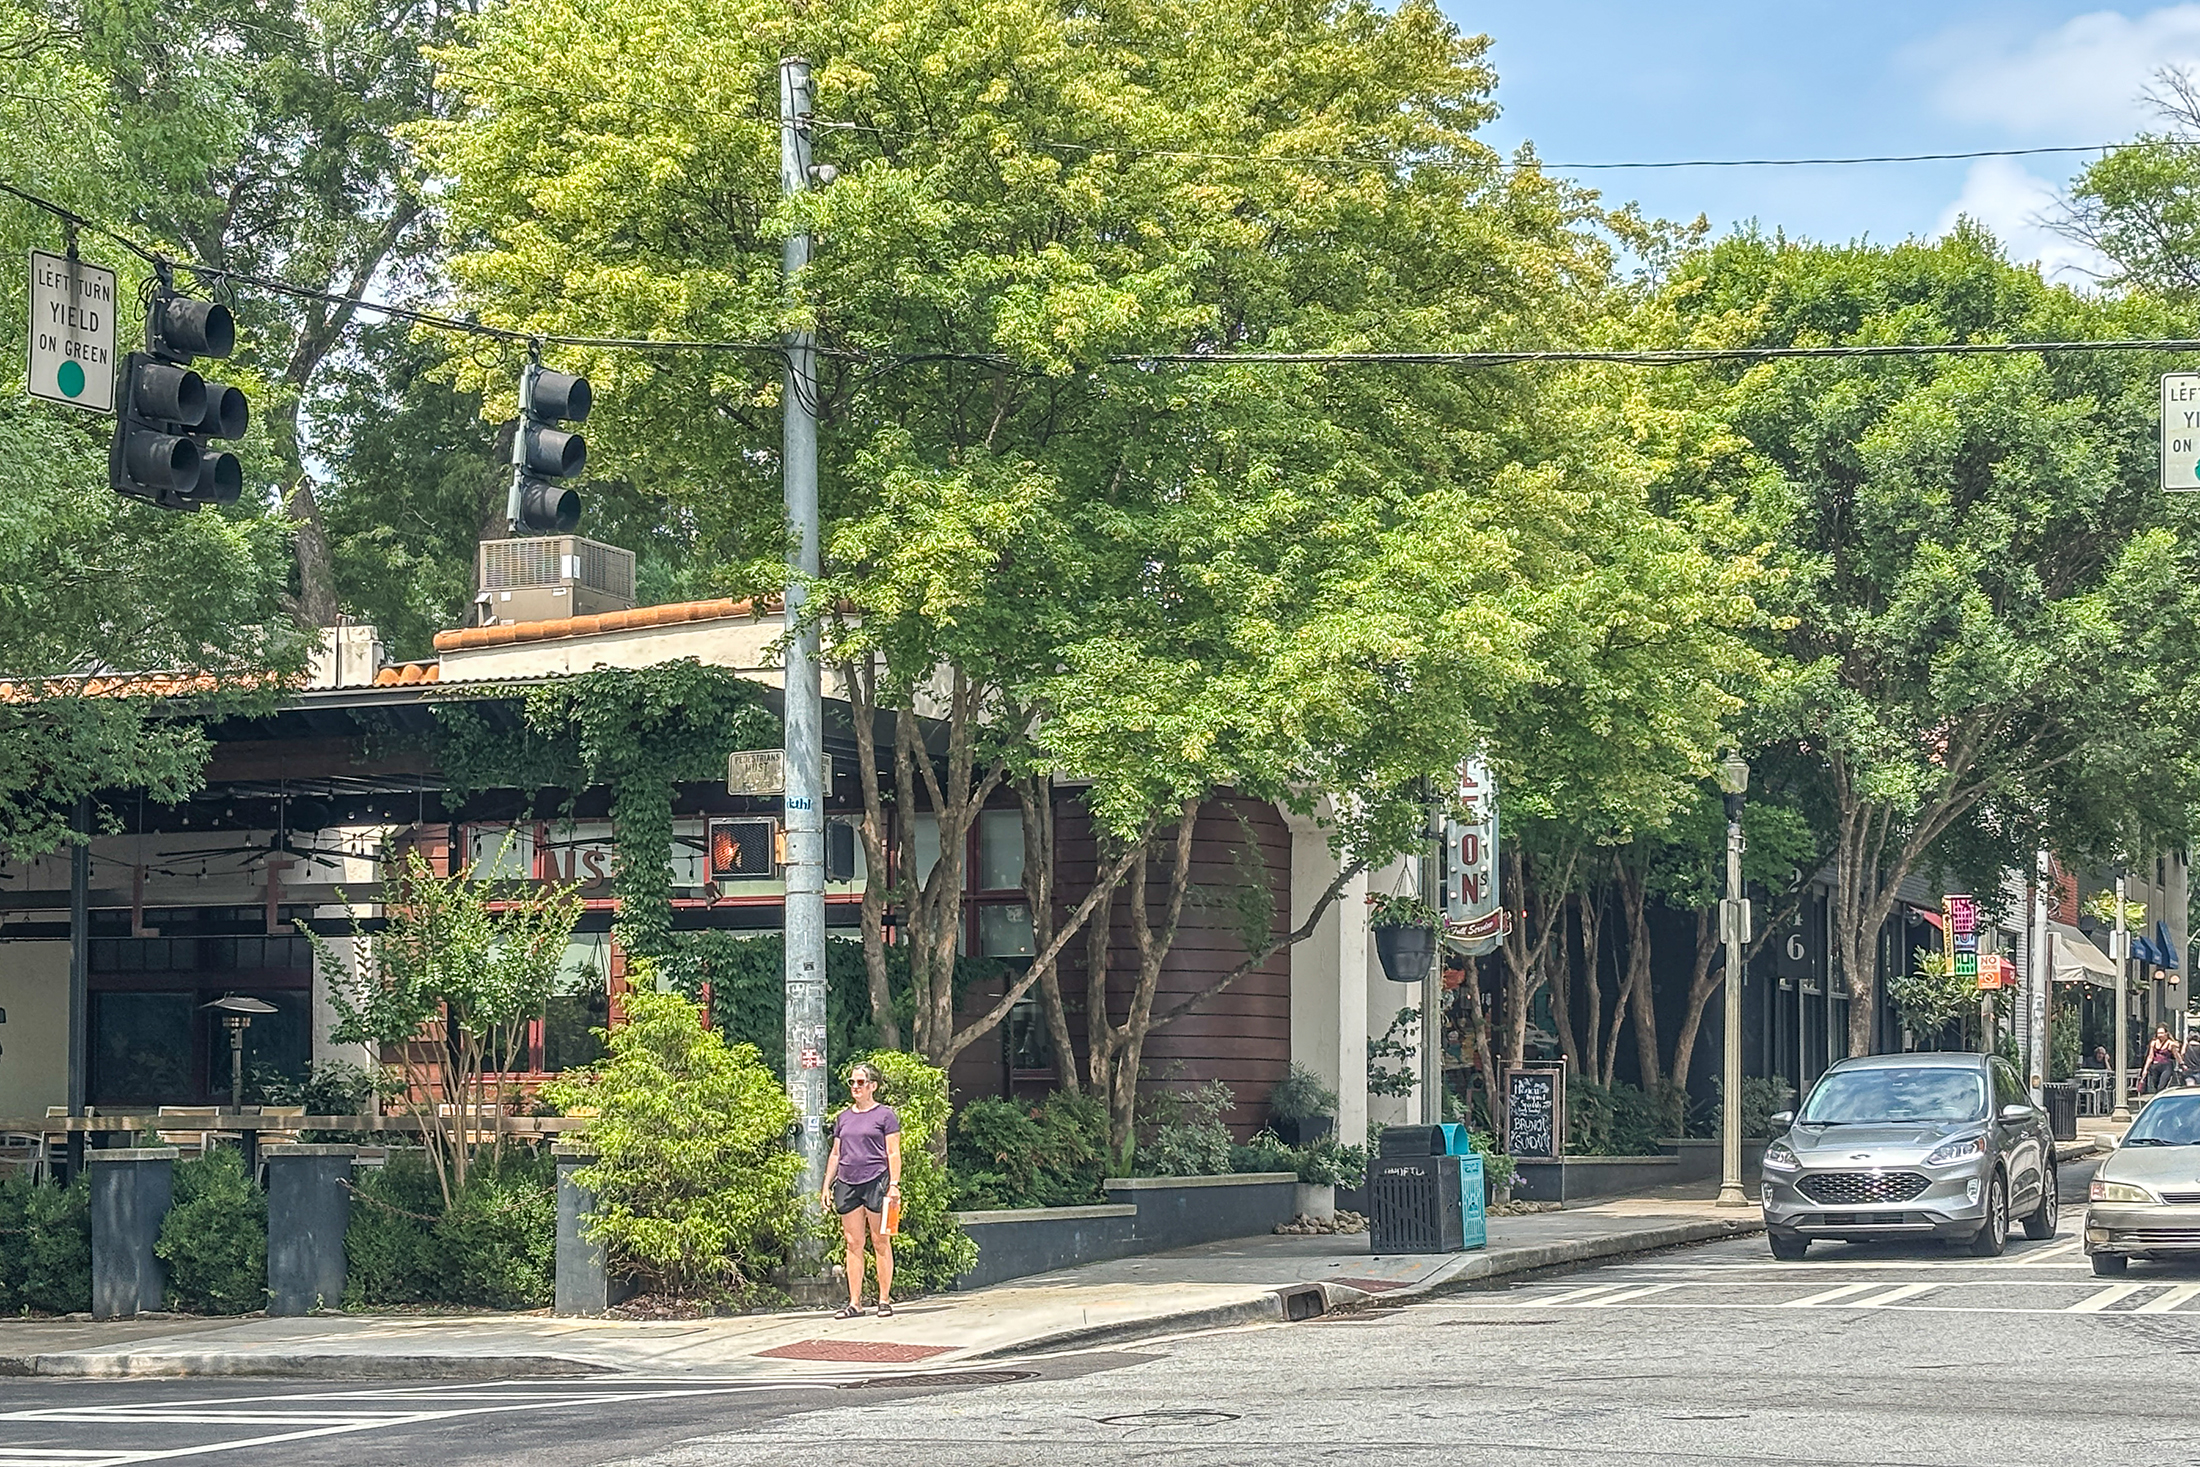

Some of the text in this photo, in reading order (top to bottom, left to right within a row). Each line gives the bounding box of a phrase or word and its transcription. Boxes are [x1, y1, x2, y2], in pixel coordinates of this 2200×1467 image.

[39, 268, 110, 302] LEFT TURN
[50, 301, 99, 332] YIELD
[39, 333, 107, 365] ON GREEN
[2173, 439, 2192, 453] ON
[734, 753, 780, 764] PEDESTRIANS
[745, 762, 769, 773] MUST
[1980, 956, 1997, 965] NO
